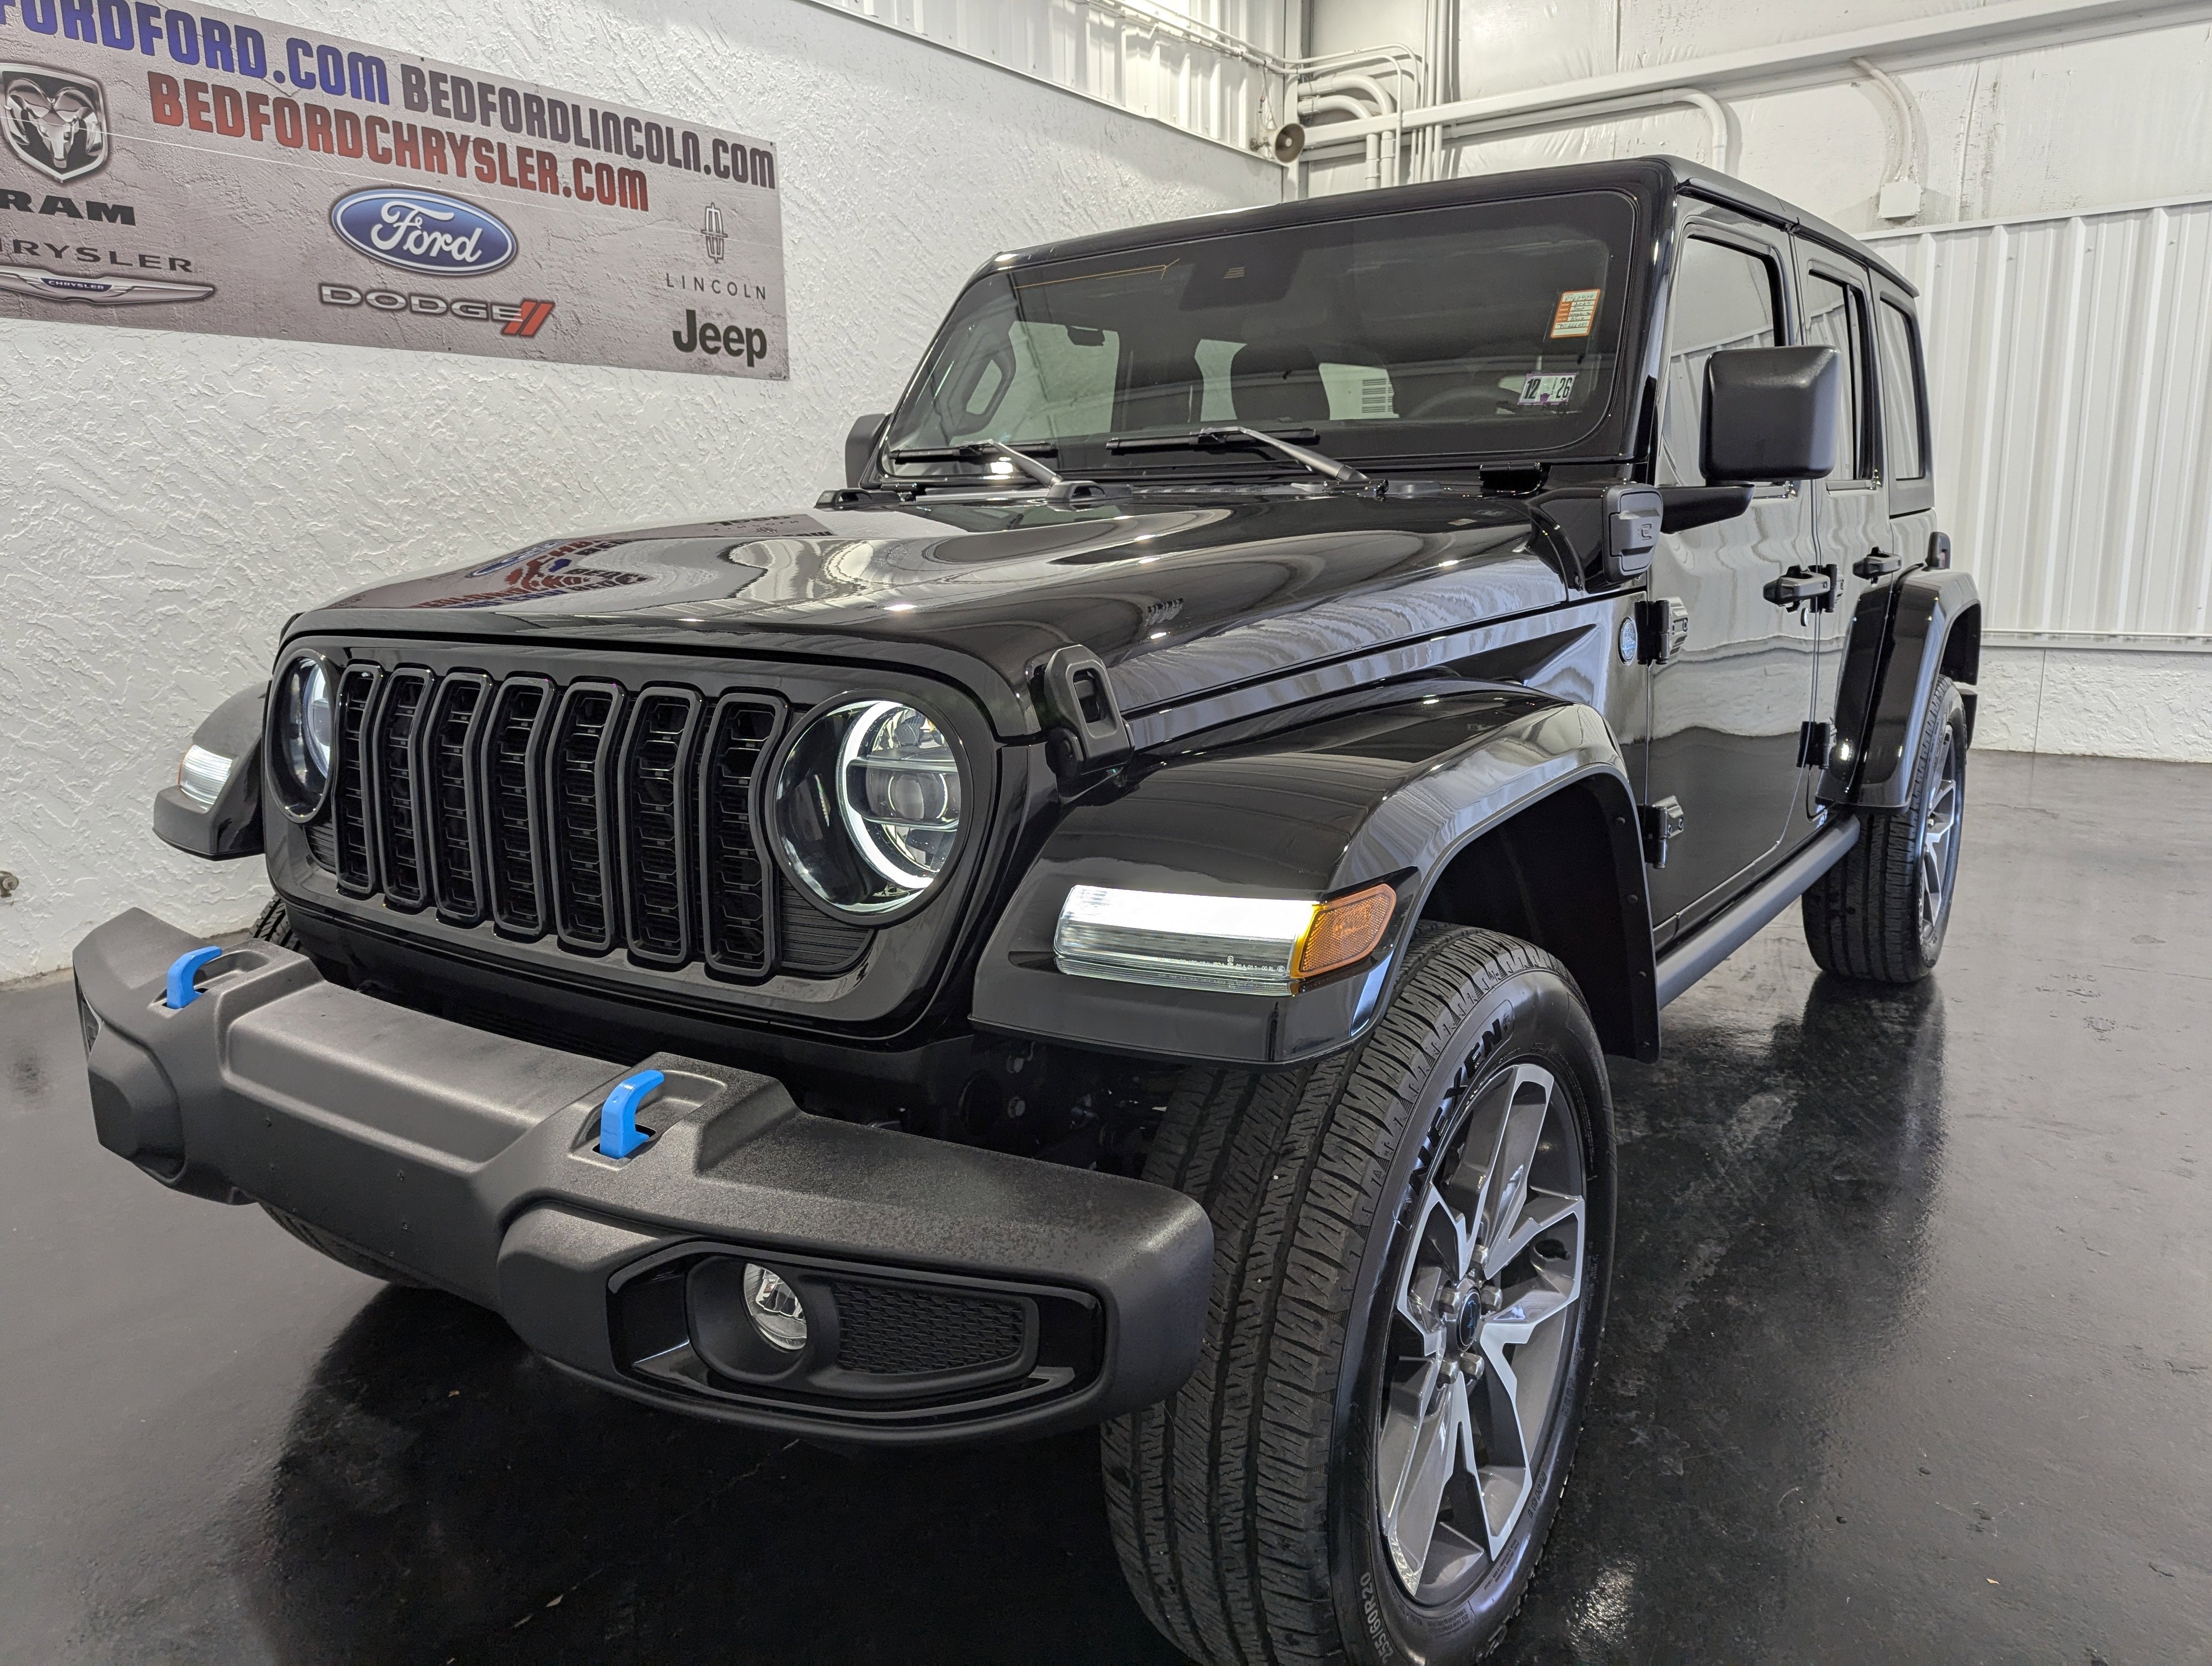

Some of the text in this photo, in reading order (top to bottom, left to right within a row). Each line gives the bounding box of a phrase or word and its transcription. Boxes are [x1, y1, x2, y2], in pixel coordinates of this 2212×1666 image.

[0, 0, 775, 189] ORDFORD.COM BEDFORDLINCOLN.COM
[147, 71, 649, 212] BEDFORDCHRYSLER.COM
[0, 189, 136, 226] RAM
[371, 200, 483, 264] Ford
[0, 238, 192, 273] RYSLER
[48, 280, 104, 290] CHRYSLER
[666, 273, 767, 300] LINCOLN
[321, 286, 524, 321] DODGE
[673, 309, 767, 367] Jeep
[1525, 379, 1541, 399] 12
[1555, 377, 1572, 399] 26
[1409, 1018, 1503, 1197] NEXEN
